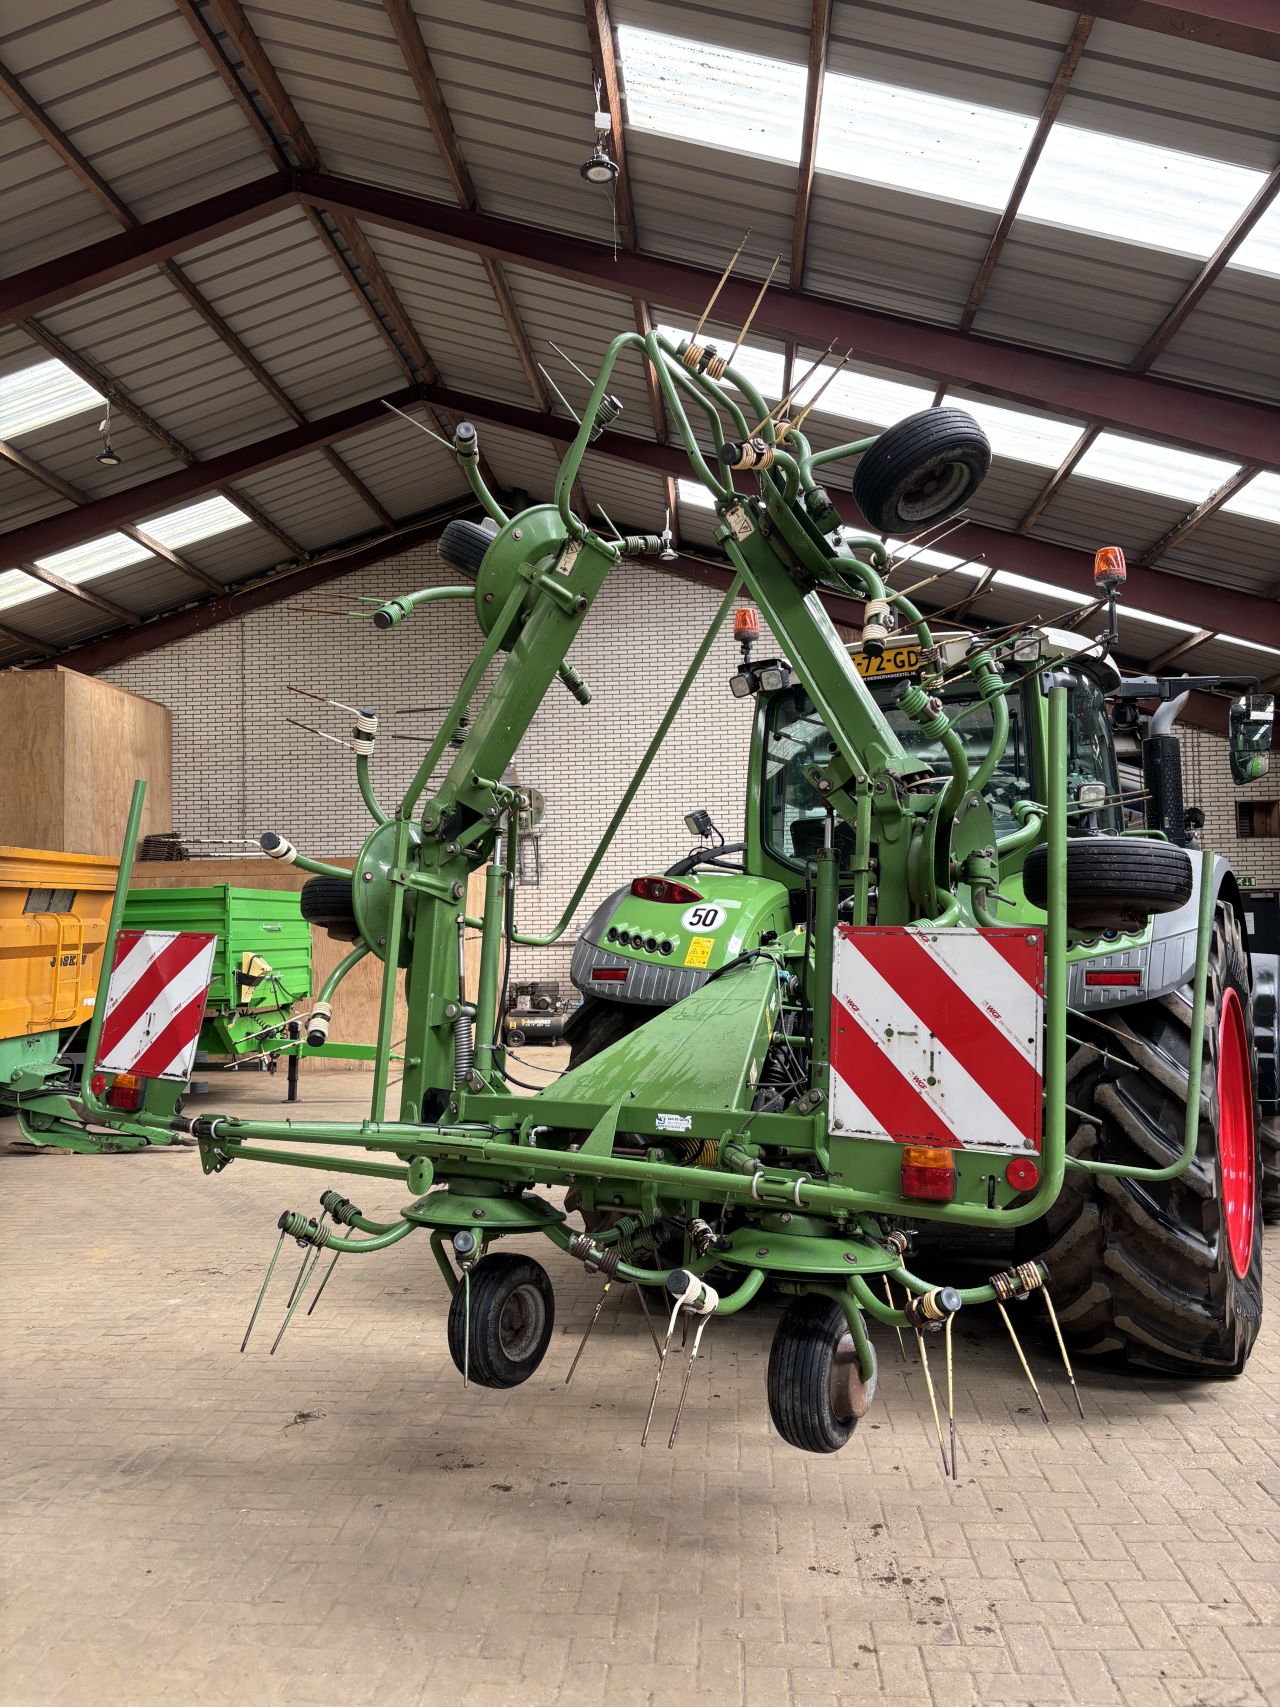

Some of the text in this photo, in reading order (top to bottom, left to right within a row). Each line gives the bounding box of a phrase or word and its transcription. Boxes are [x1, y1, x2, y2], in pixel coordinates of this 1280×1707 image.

[852, 650, 919, 673] -72-GD
[689, 908, 719, 927] 50
[846, 998, 861, 1012] WGF
[986, 1004, 1002, 1020] WGF
[913, 1075, 928, 1089] WGF
